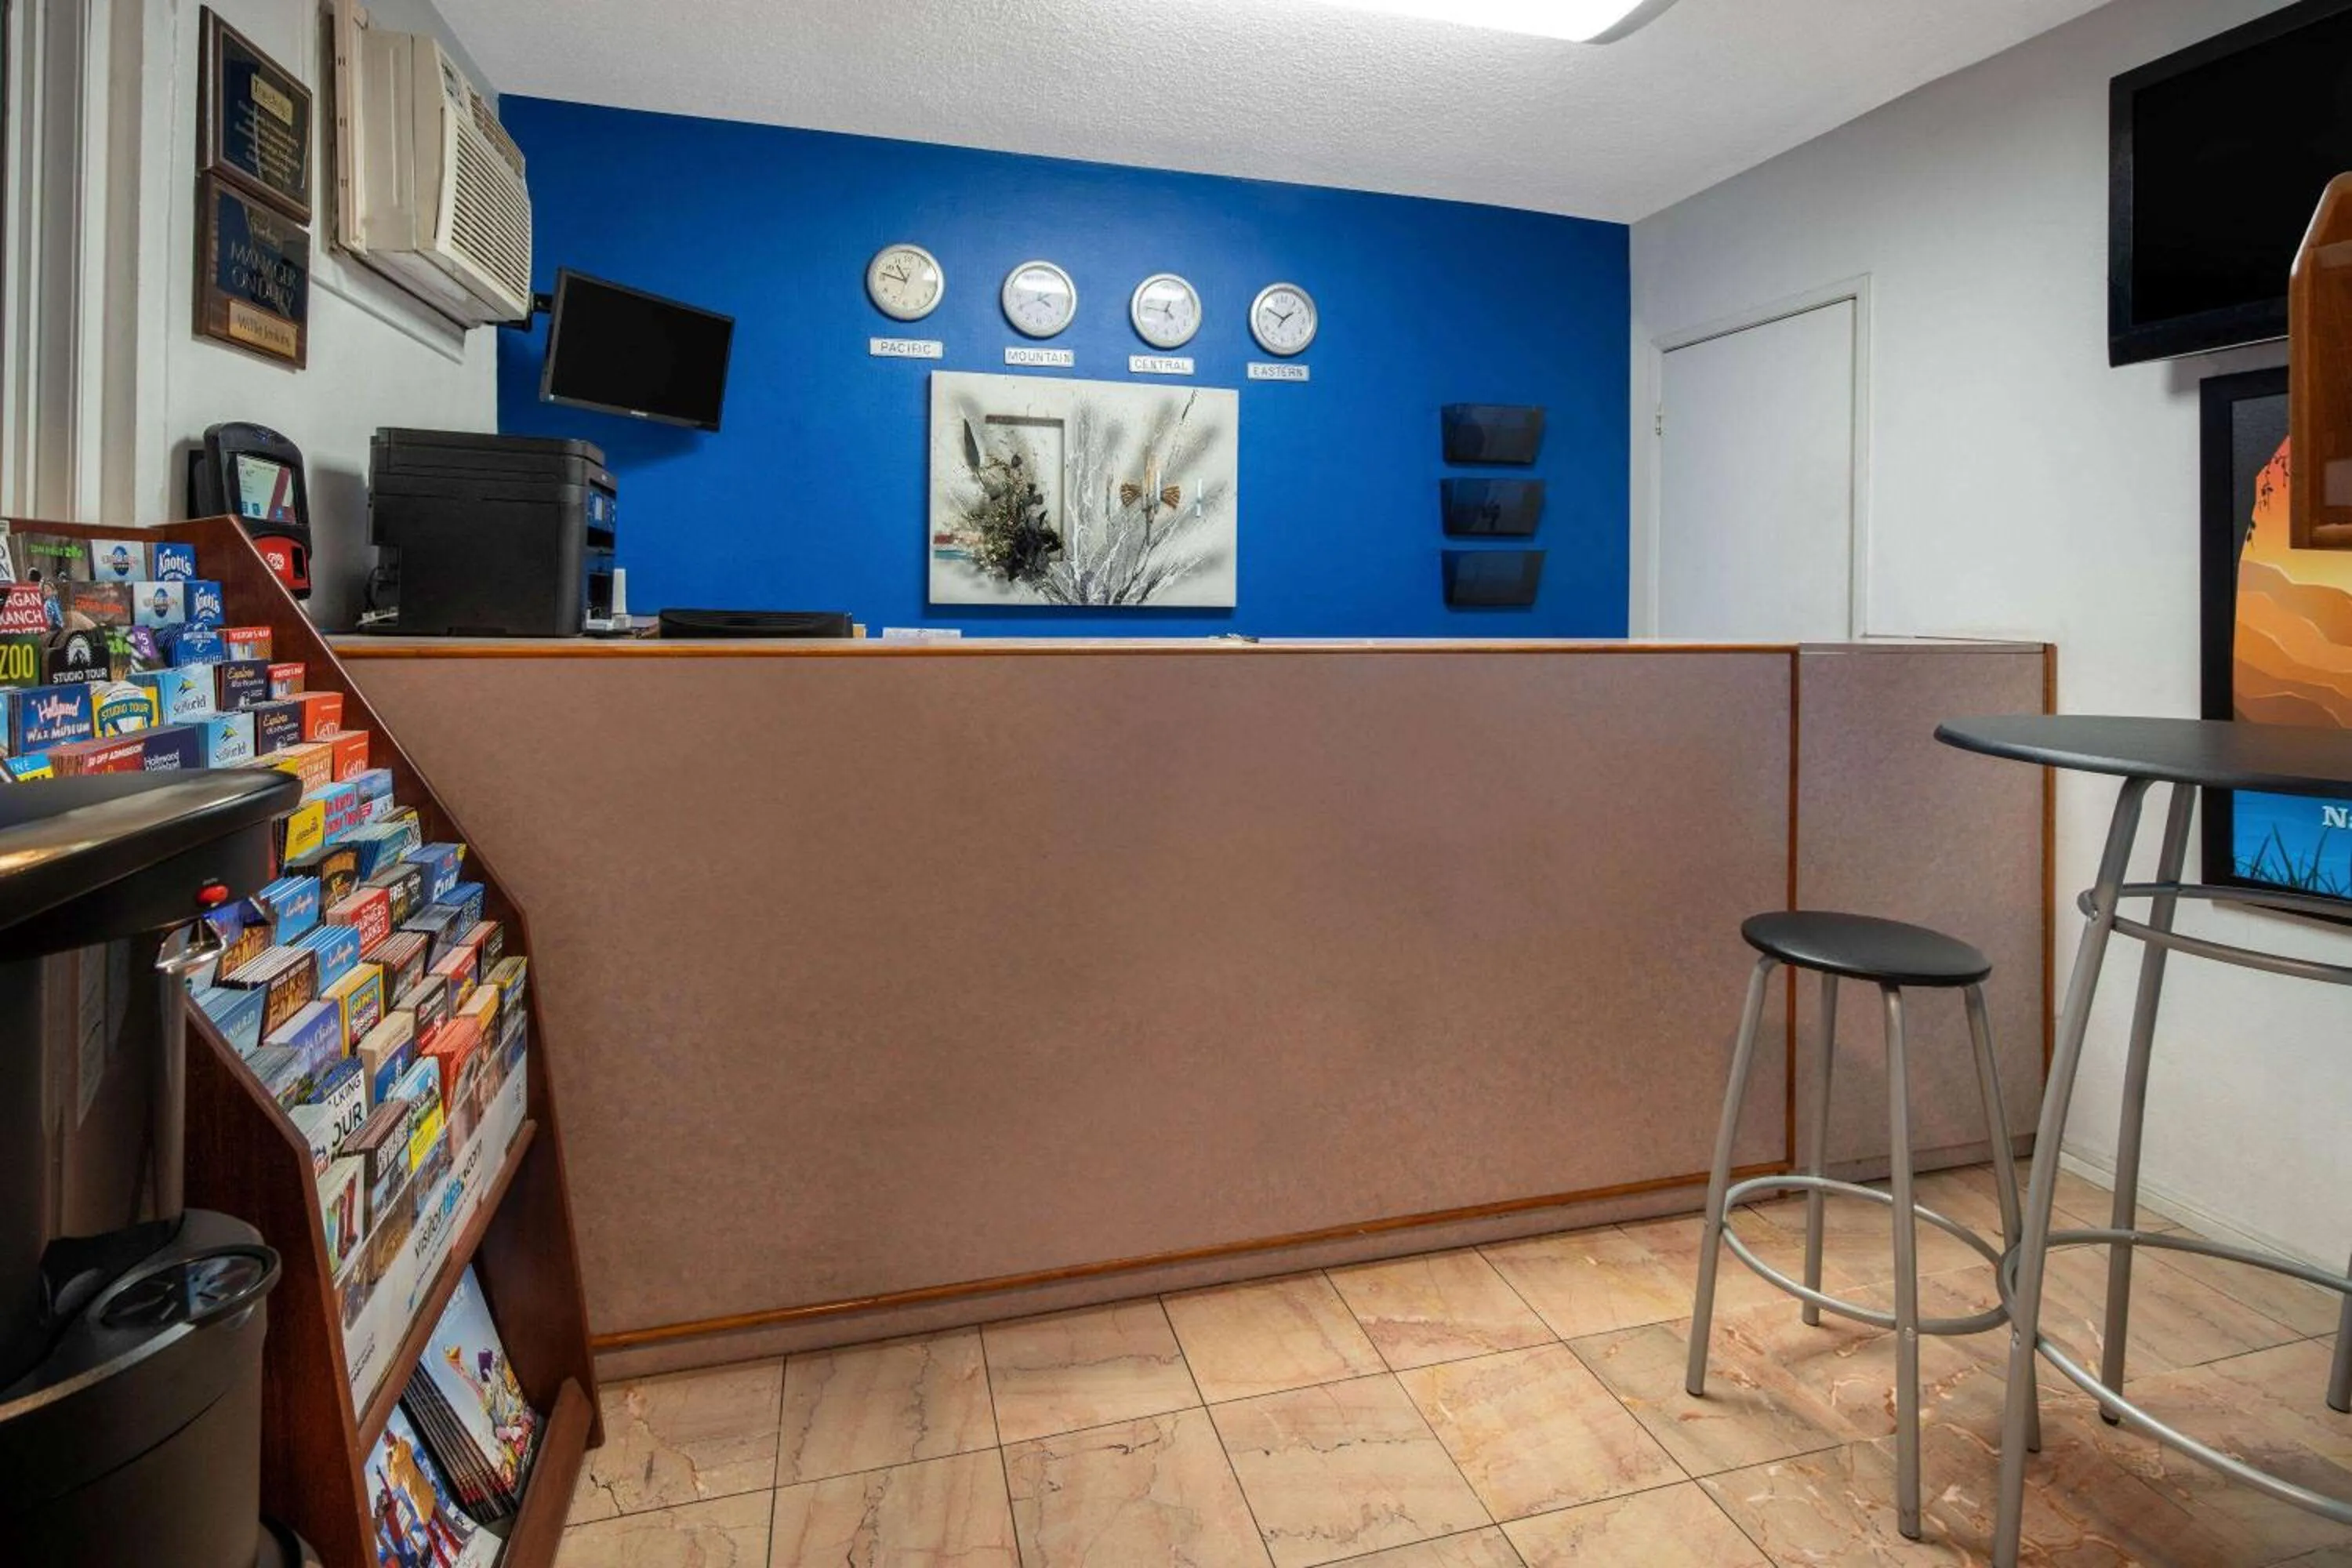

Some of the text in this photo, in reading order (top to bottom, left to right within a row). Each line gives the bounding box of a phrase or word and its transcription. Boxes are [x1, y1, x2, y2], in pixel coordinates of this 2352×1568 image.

[880, 341, 932, 355] PACIFIC
[1007, 350, 1071, 363] MOUNTAIN
[1134, 358, 1189, 371] CENTRAL
[1254, 365, 1304, 378] EASTERN
[158, 552, 192, 578] Knott's
[5, 592, 42, 608] AGAN
[0, 644, 35, 680] ZOO
[53, 667, 108, 684] STUDIO TOUR
[100, 703, 128, 720] STUDIO
[2321, 804, 2352, 829] N
[332, 1101, 363, 1148] OUR
